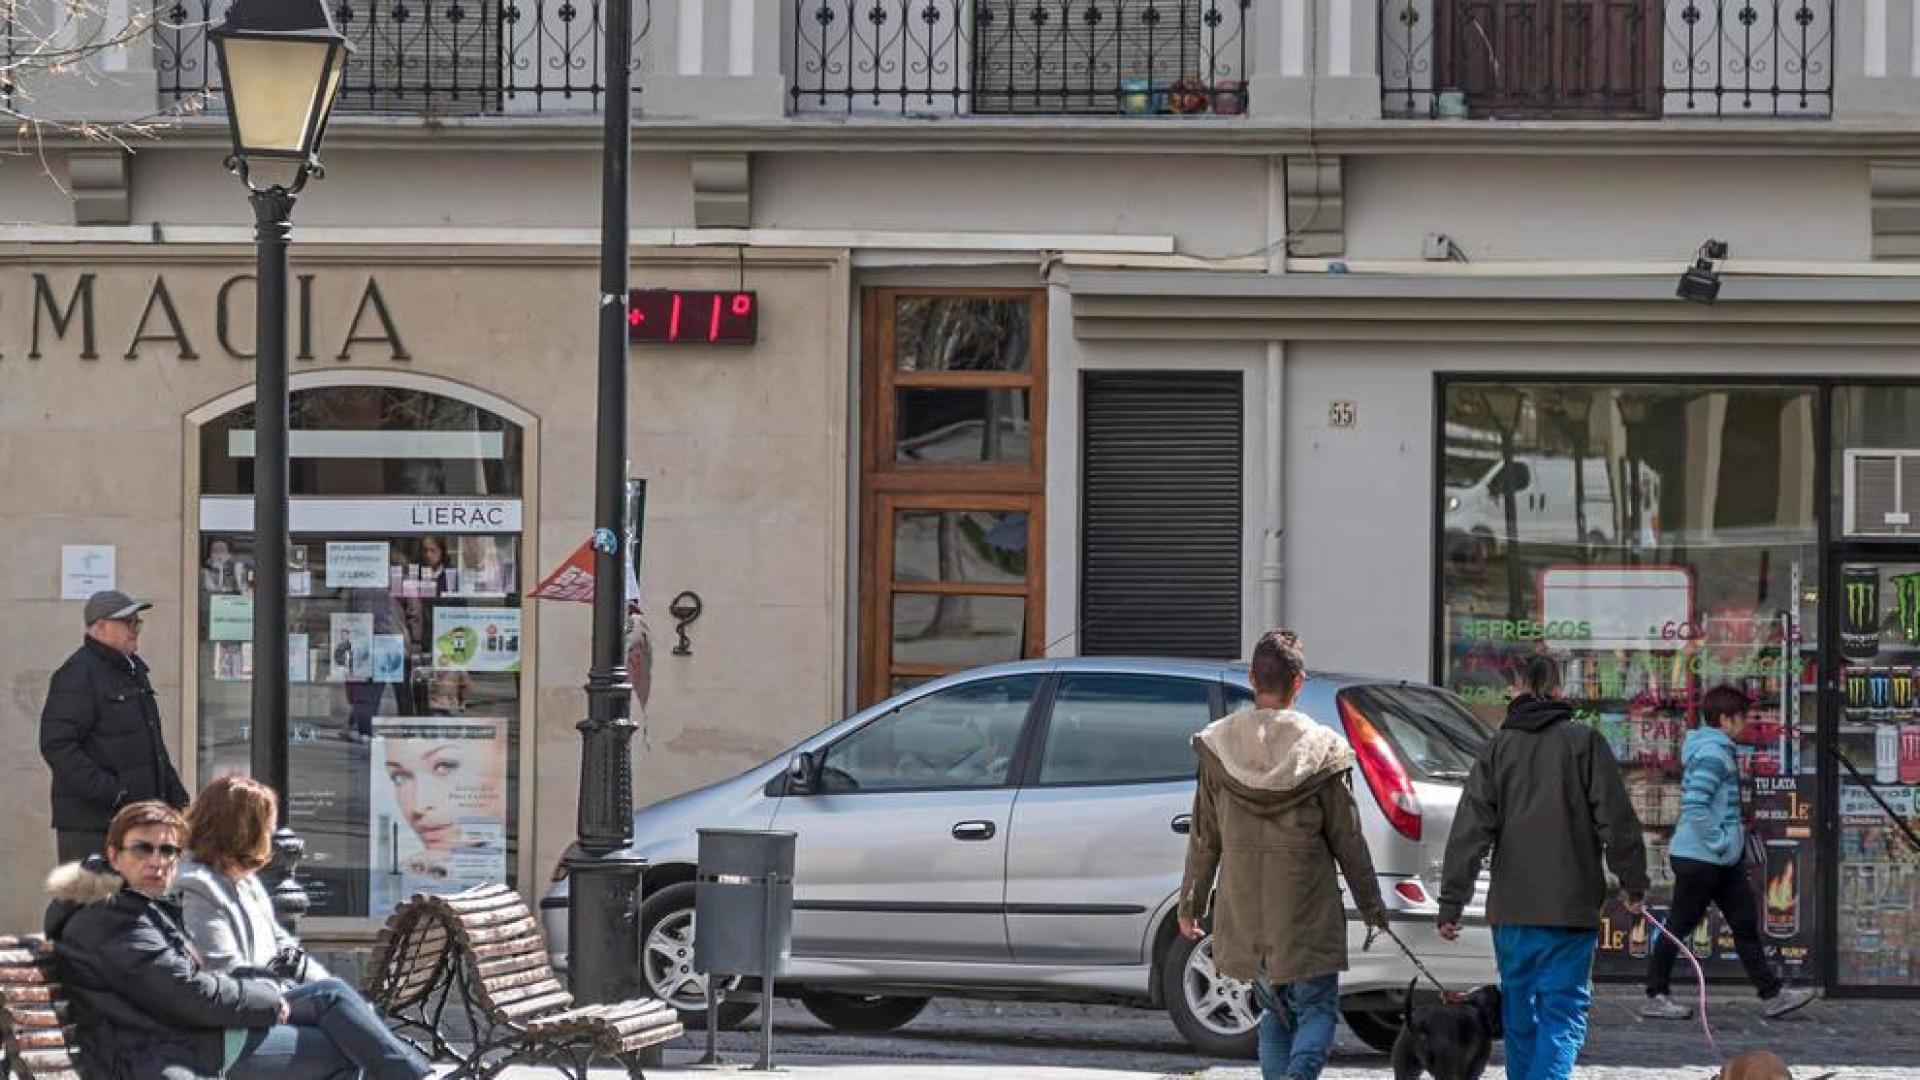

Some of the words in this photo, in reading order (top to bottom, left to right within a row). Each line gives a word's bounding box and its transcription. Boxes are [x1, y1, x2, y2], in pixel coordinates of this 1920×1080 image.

[0, 273, 411, 360] MACIA
[1333, 402, 1353, 425] 55
[412, 507, 503, 525] LIERAC
[1461, 619, 1593, 640] REFRESCOS
